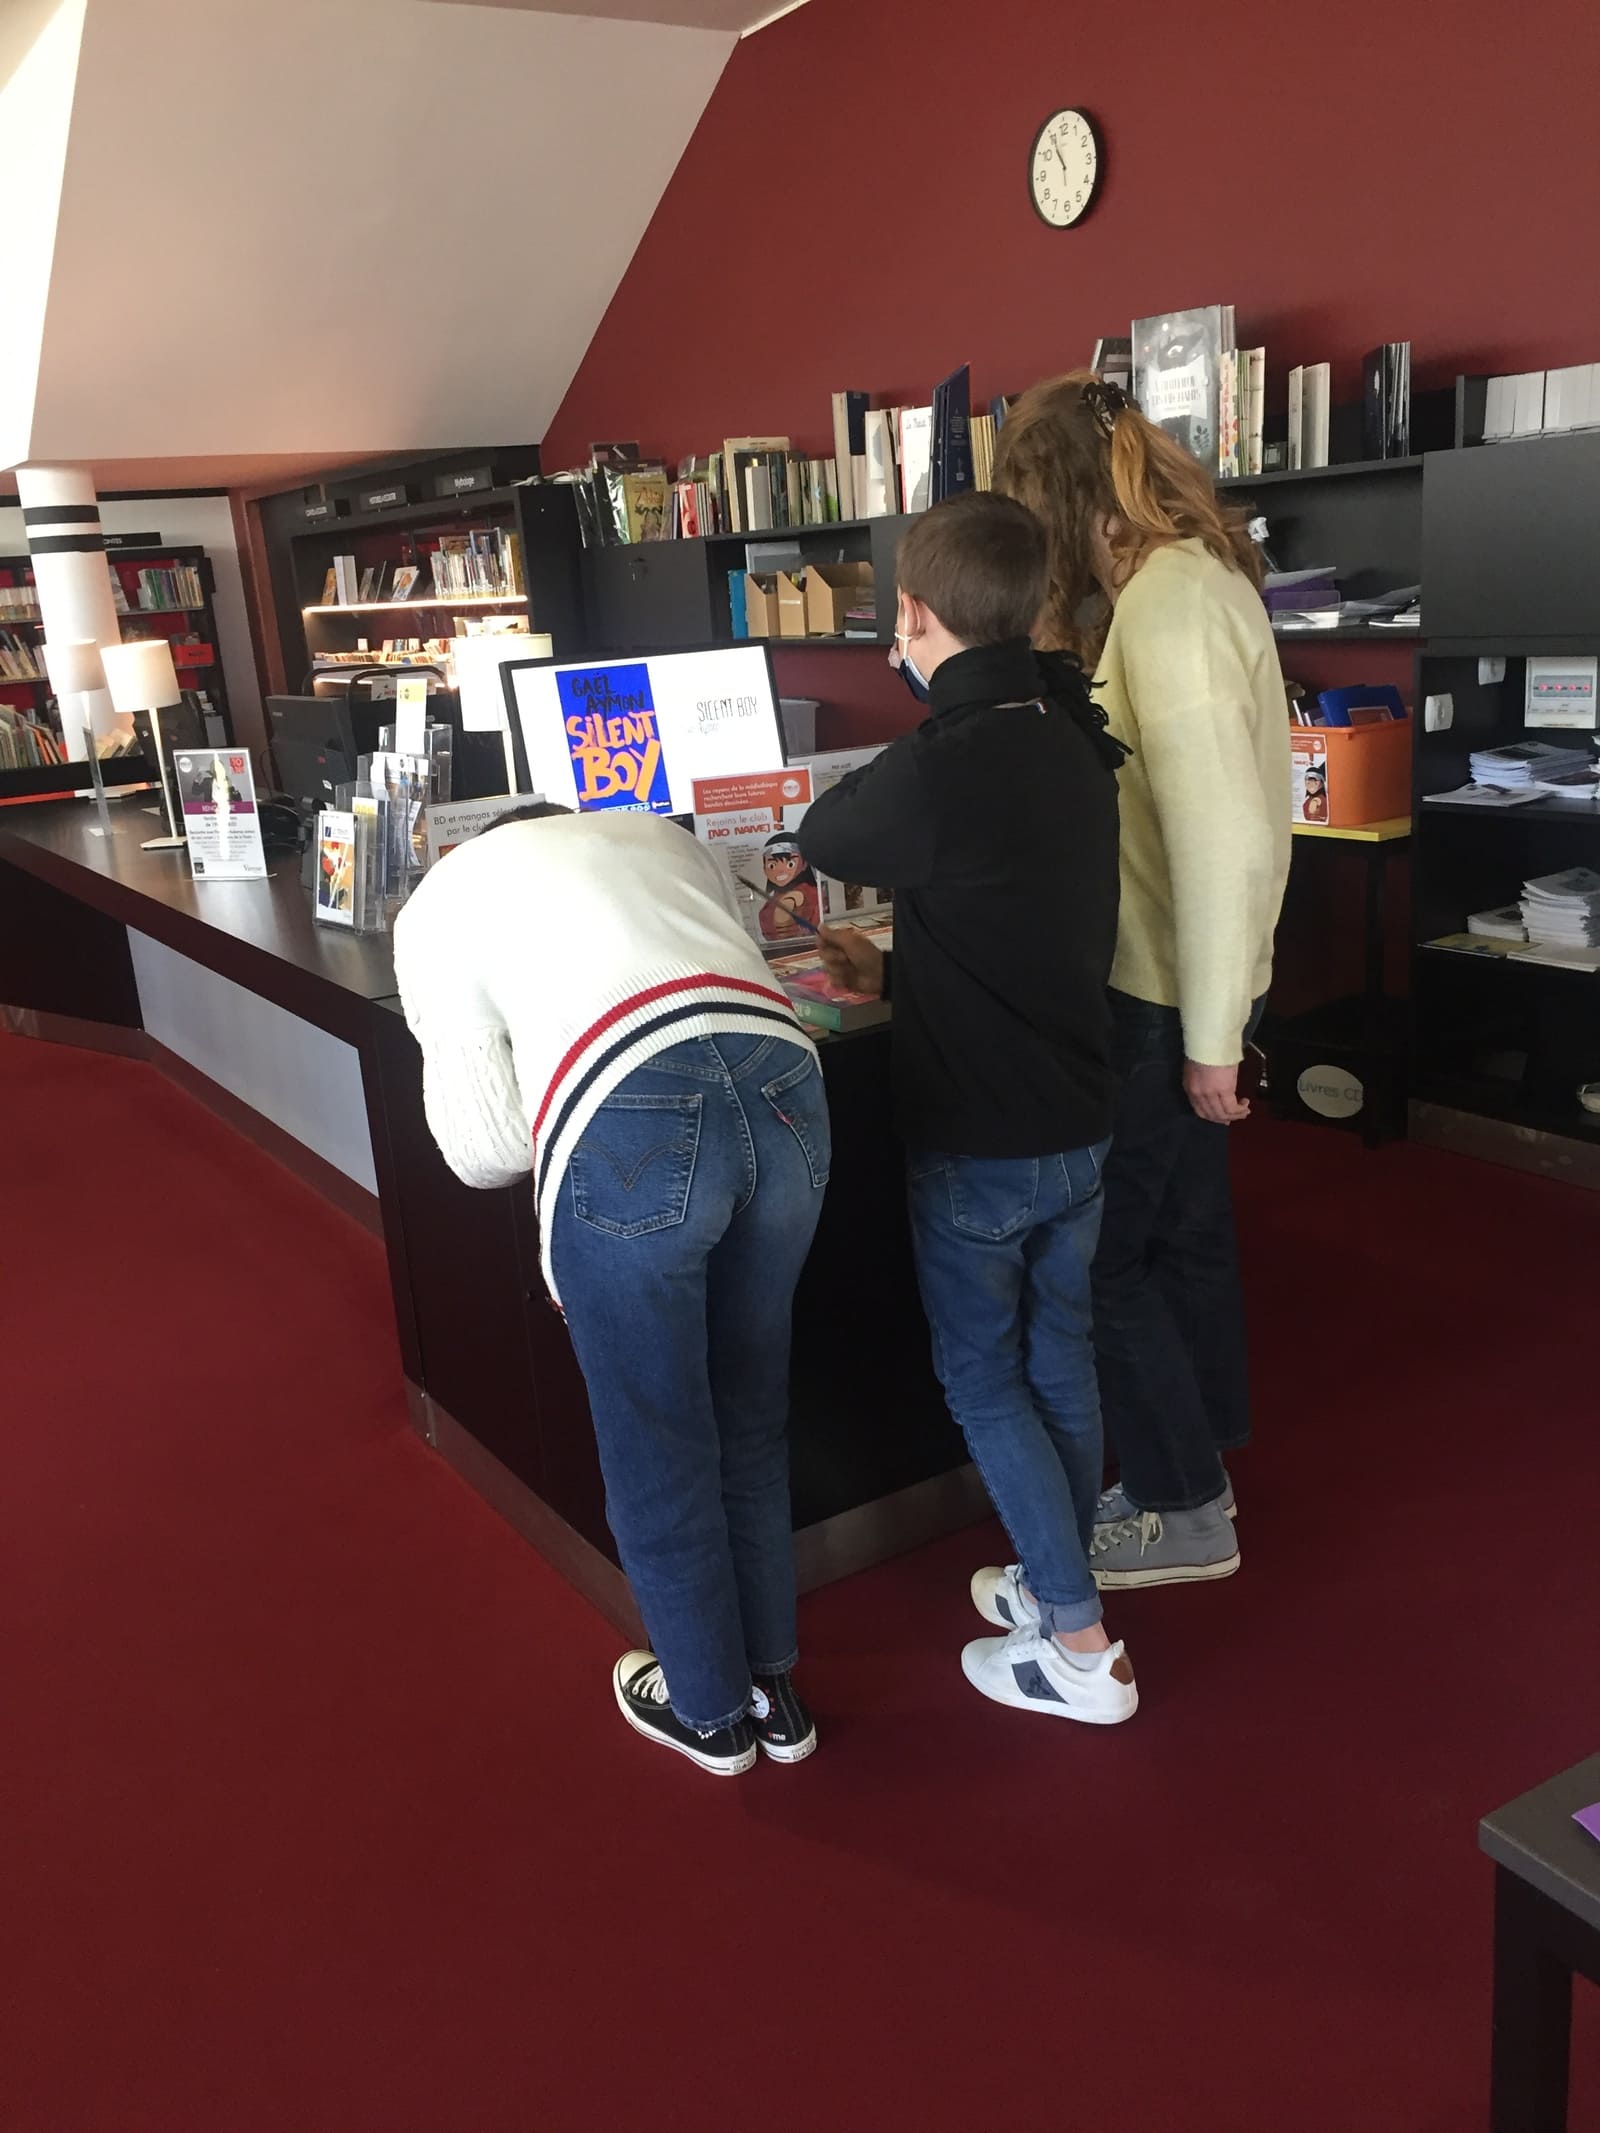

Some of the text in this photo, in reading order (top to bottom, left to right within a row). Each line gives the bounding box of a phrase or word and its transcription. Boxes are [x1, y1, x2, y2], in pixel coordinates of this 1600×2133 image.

[1059, 123, 1069, 136] 12
[1073, 124, 1078, 136] 1
[1049, 133, 1057, 145] 11
[1081, 135, 1088, 148] 2
[1042, 149, 1053, 161] 10
[1086, 153, 1092, 165] 3
[1040, 170, 1047, 182] 9
[1083, 174, 1090, 184] 4
[1044, 188, 1051, 200] 8
[1076, 190, 1082, 203] 5
[1052, 199, 1059, 211] 7
[1063, 200, 1071, 212] 6
[571, 672, 616, 698] GAËL
[586, 690, 645, 718] AYMON
[736, 696, 758, 718] BOY
[571, 737, 661, 802] BOY
[433, 815, 446, 825] BD
[448, 816, 456, 824] et
[458, 812, 490, 822] mangas
[706, 812, 768, 828] Rejoins le club
[446, 828, 460, 837] par
[462, 824, 470, 833] le
[1299, 1079, 1340, 1098] Livres
